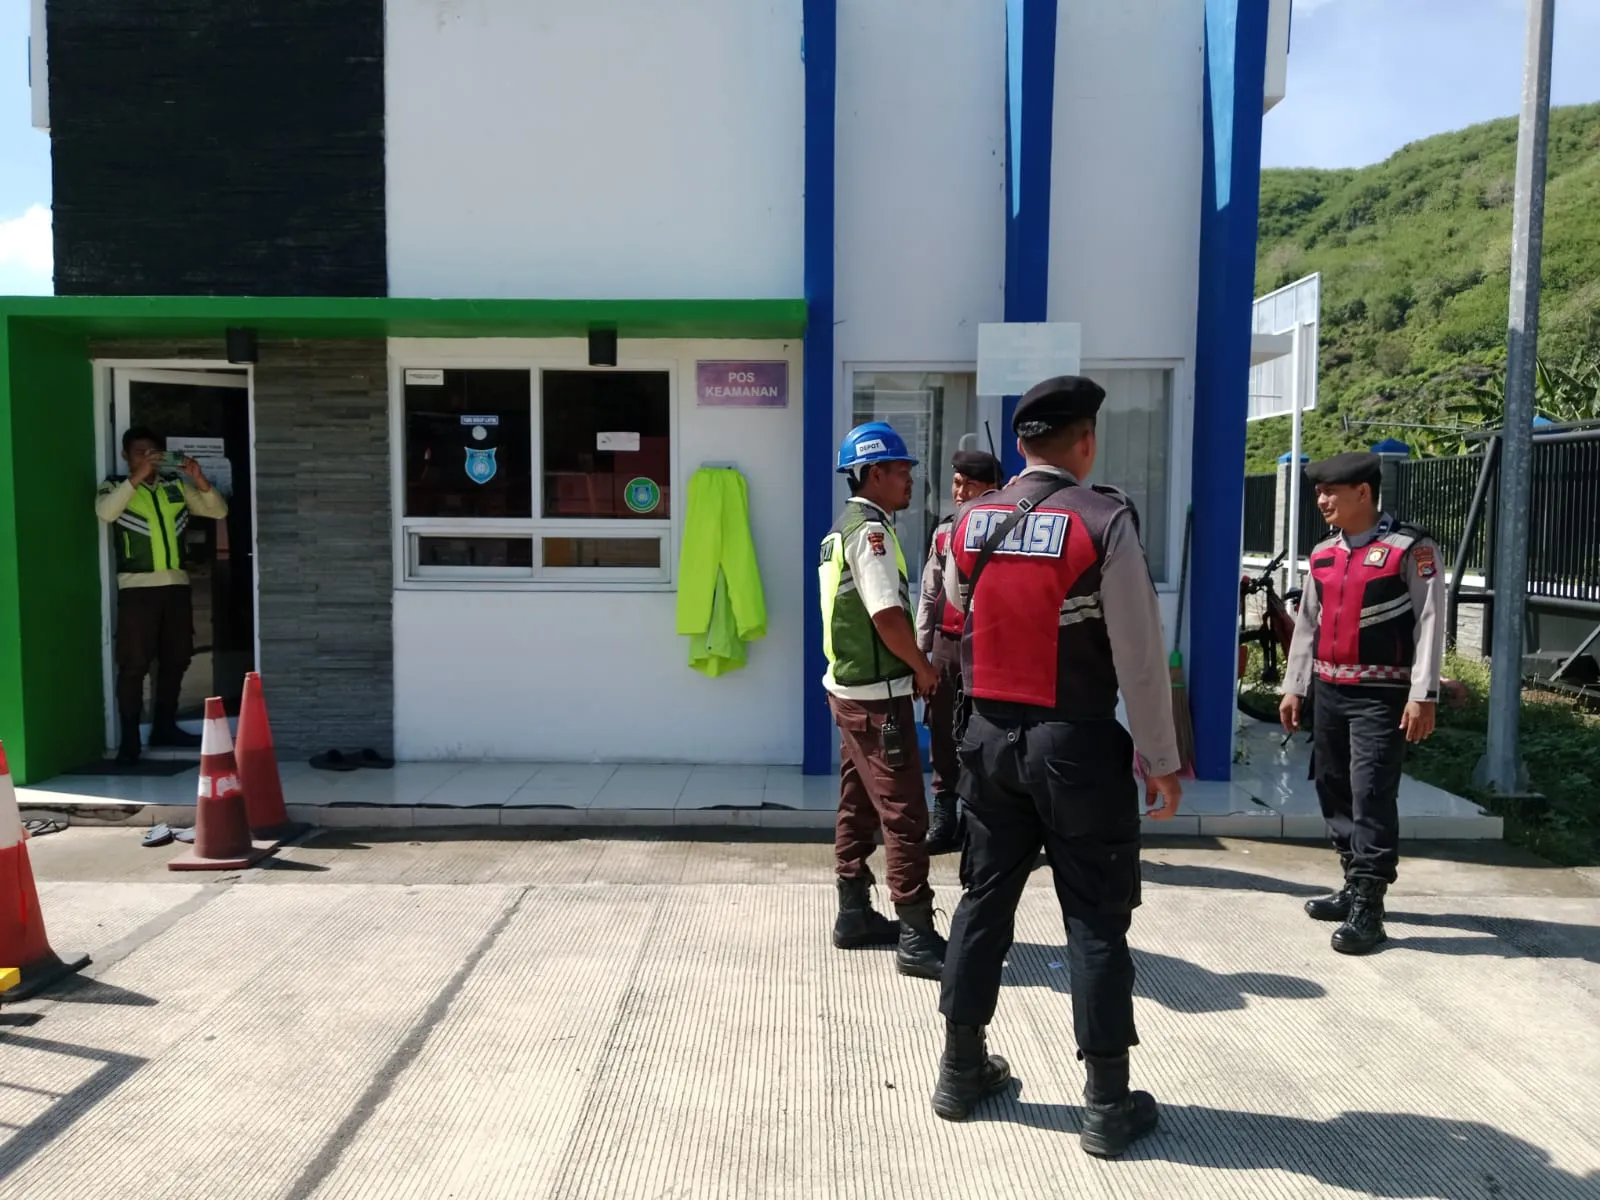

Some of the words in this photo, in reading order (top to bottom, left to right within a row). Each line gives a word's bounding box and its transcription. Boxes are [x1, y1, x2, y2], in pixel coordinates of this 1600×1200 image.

[728, 371, 755, 384] POS
[705, 386, 778, 398] KEAMANAN
[859, 442, 880, 452] DEPOT
